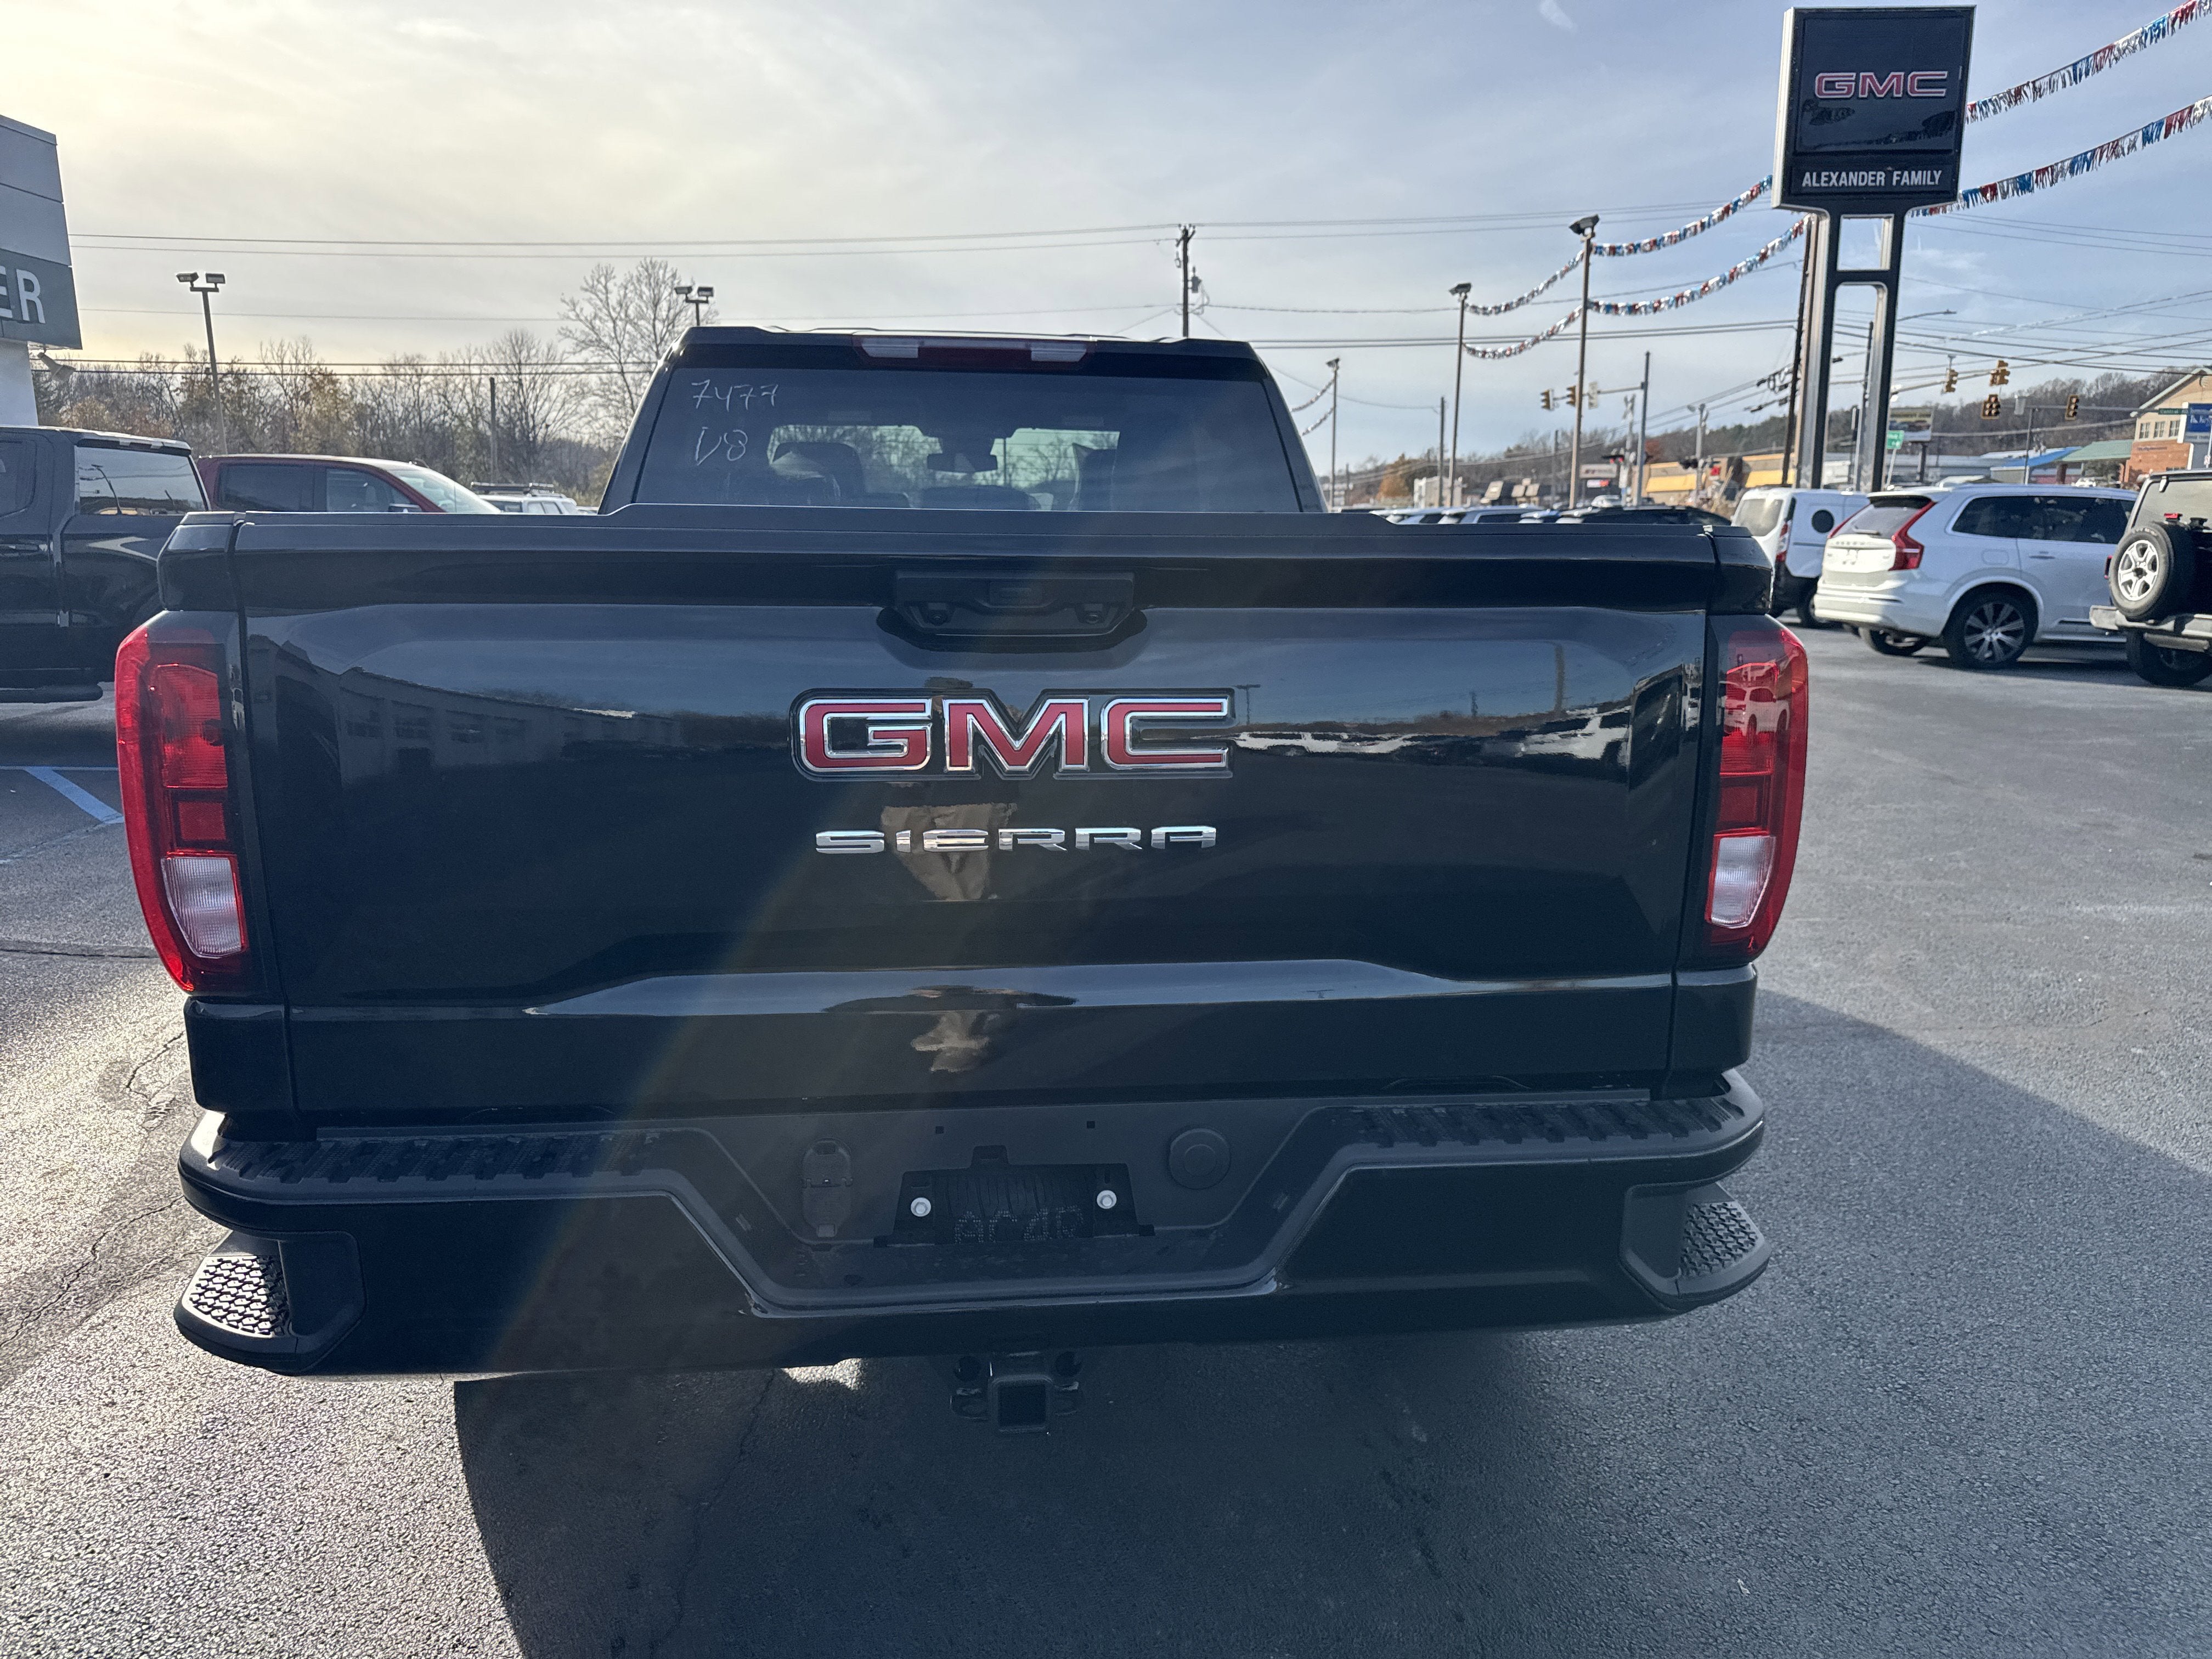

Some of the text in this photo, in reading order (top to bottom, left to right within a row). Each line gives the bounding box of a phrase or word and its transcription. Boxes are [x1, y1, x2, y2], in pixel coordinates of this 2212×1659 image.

[1815, 71, 1948, 98] GMC
[1802, 170, 1943, 187] ALEXANDER FAMILY
[691, 379, 778, 412] 7477
[696, 426, 748, 466] V8
[798, 698, 1229, 771] GMC
[815, 825, 1217, 854] SIERRA
